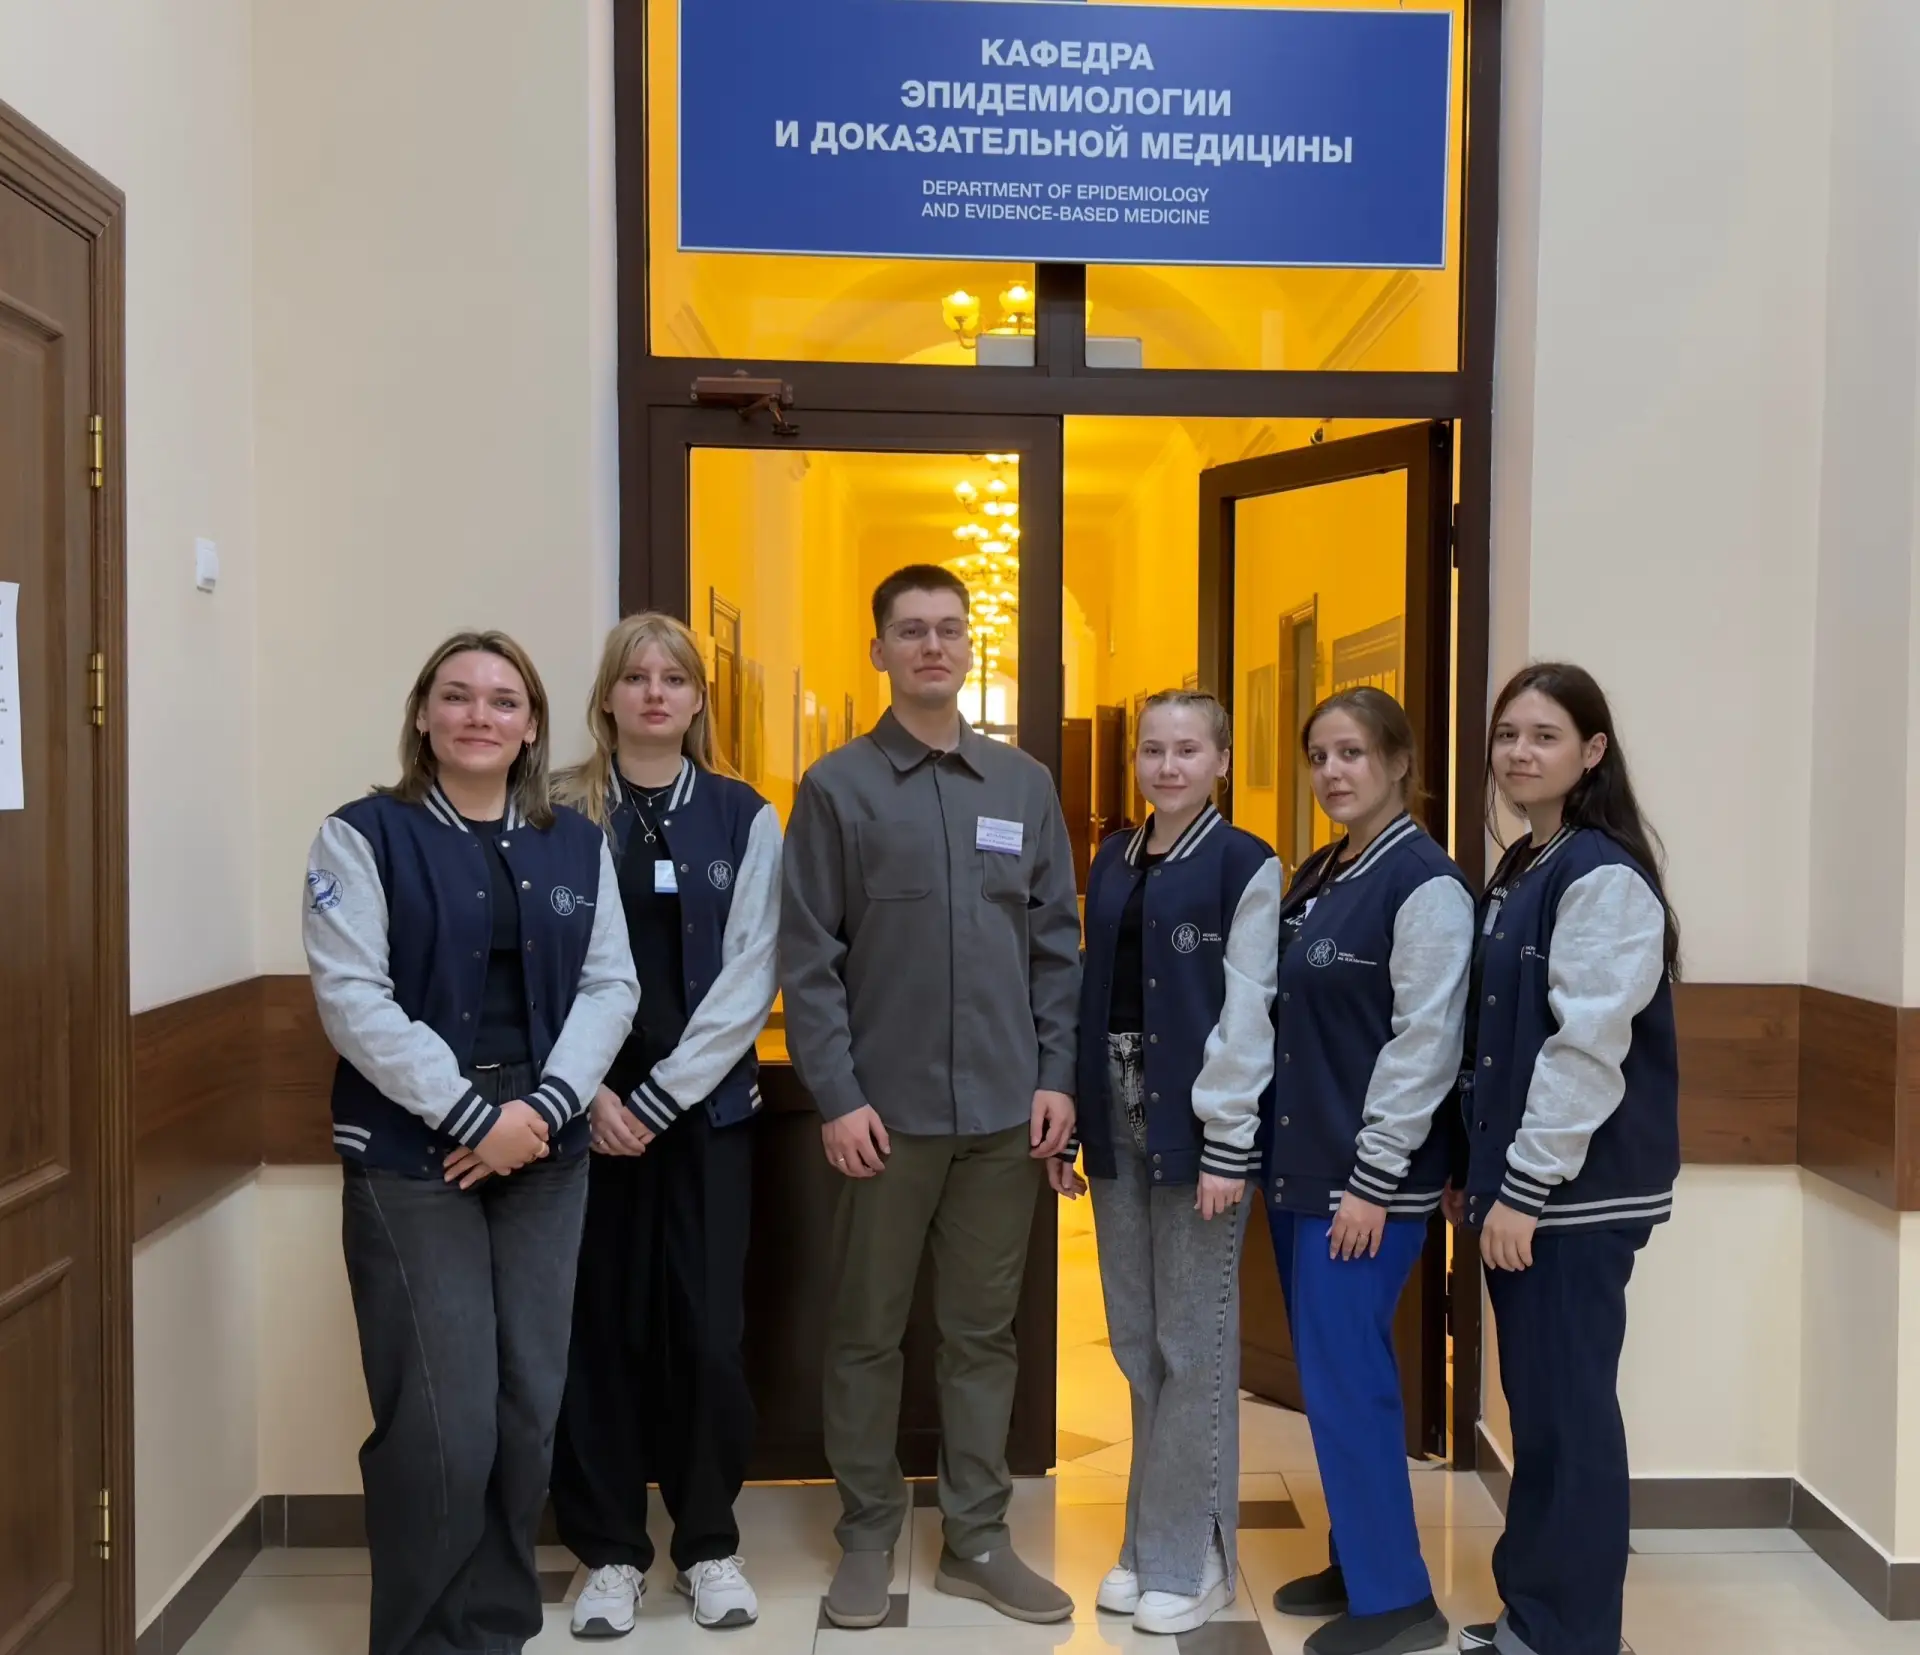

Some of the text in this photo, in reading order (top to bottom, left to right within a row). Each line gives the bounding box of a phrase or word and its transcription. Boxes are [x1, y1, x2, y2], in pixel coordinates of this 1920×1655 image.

[981, 39, 1155, 76] КАФЕДРА
[900, 80, 1231, 117] ЭПИДЕМИОЛОГИИ
[775, 120, 1353, 168] И ДОКАЗАТЕЛЬНОЙ МЕДИЦИНЫ
[922, 180, 1210, 203] DEPARTMENT OF EPIDEMIOLOGY
[921, 202, 1210, 225] AND EVIDENCE-BASED MEDICINE
